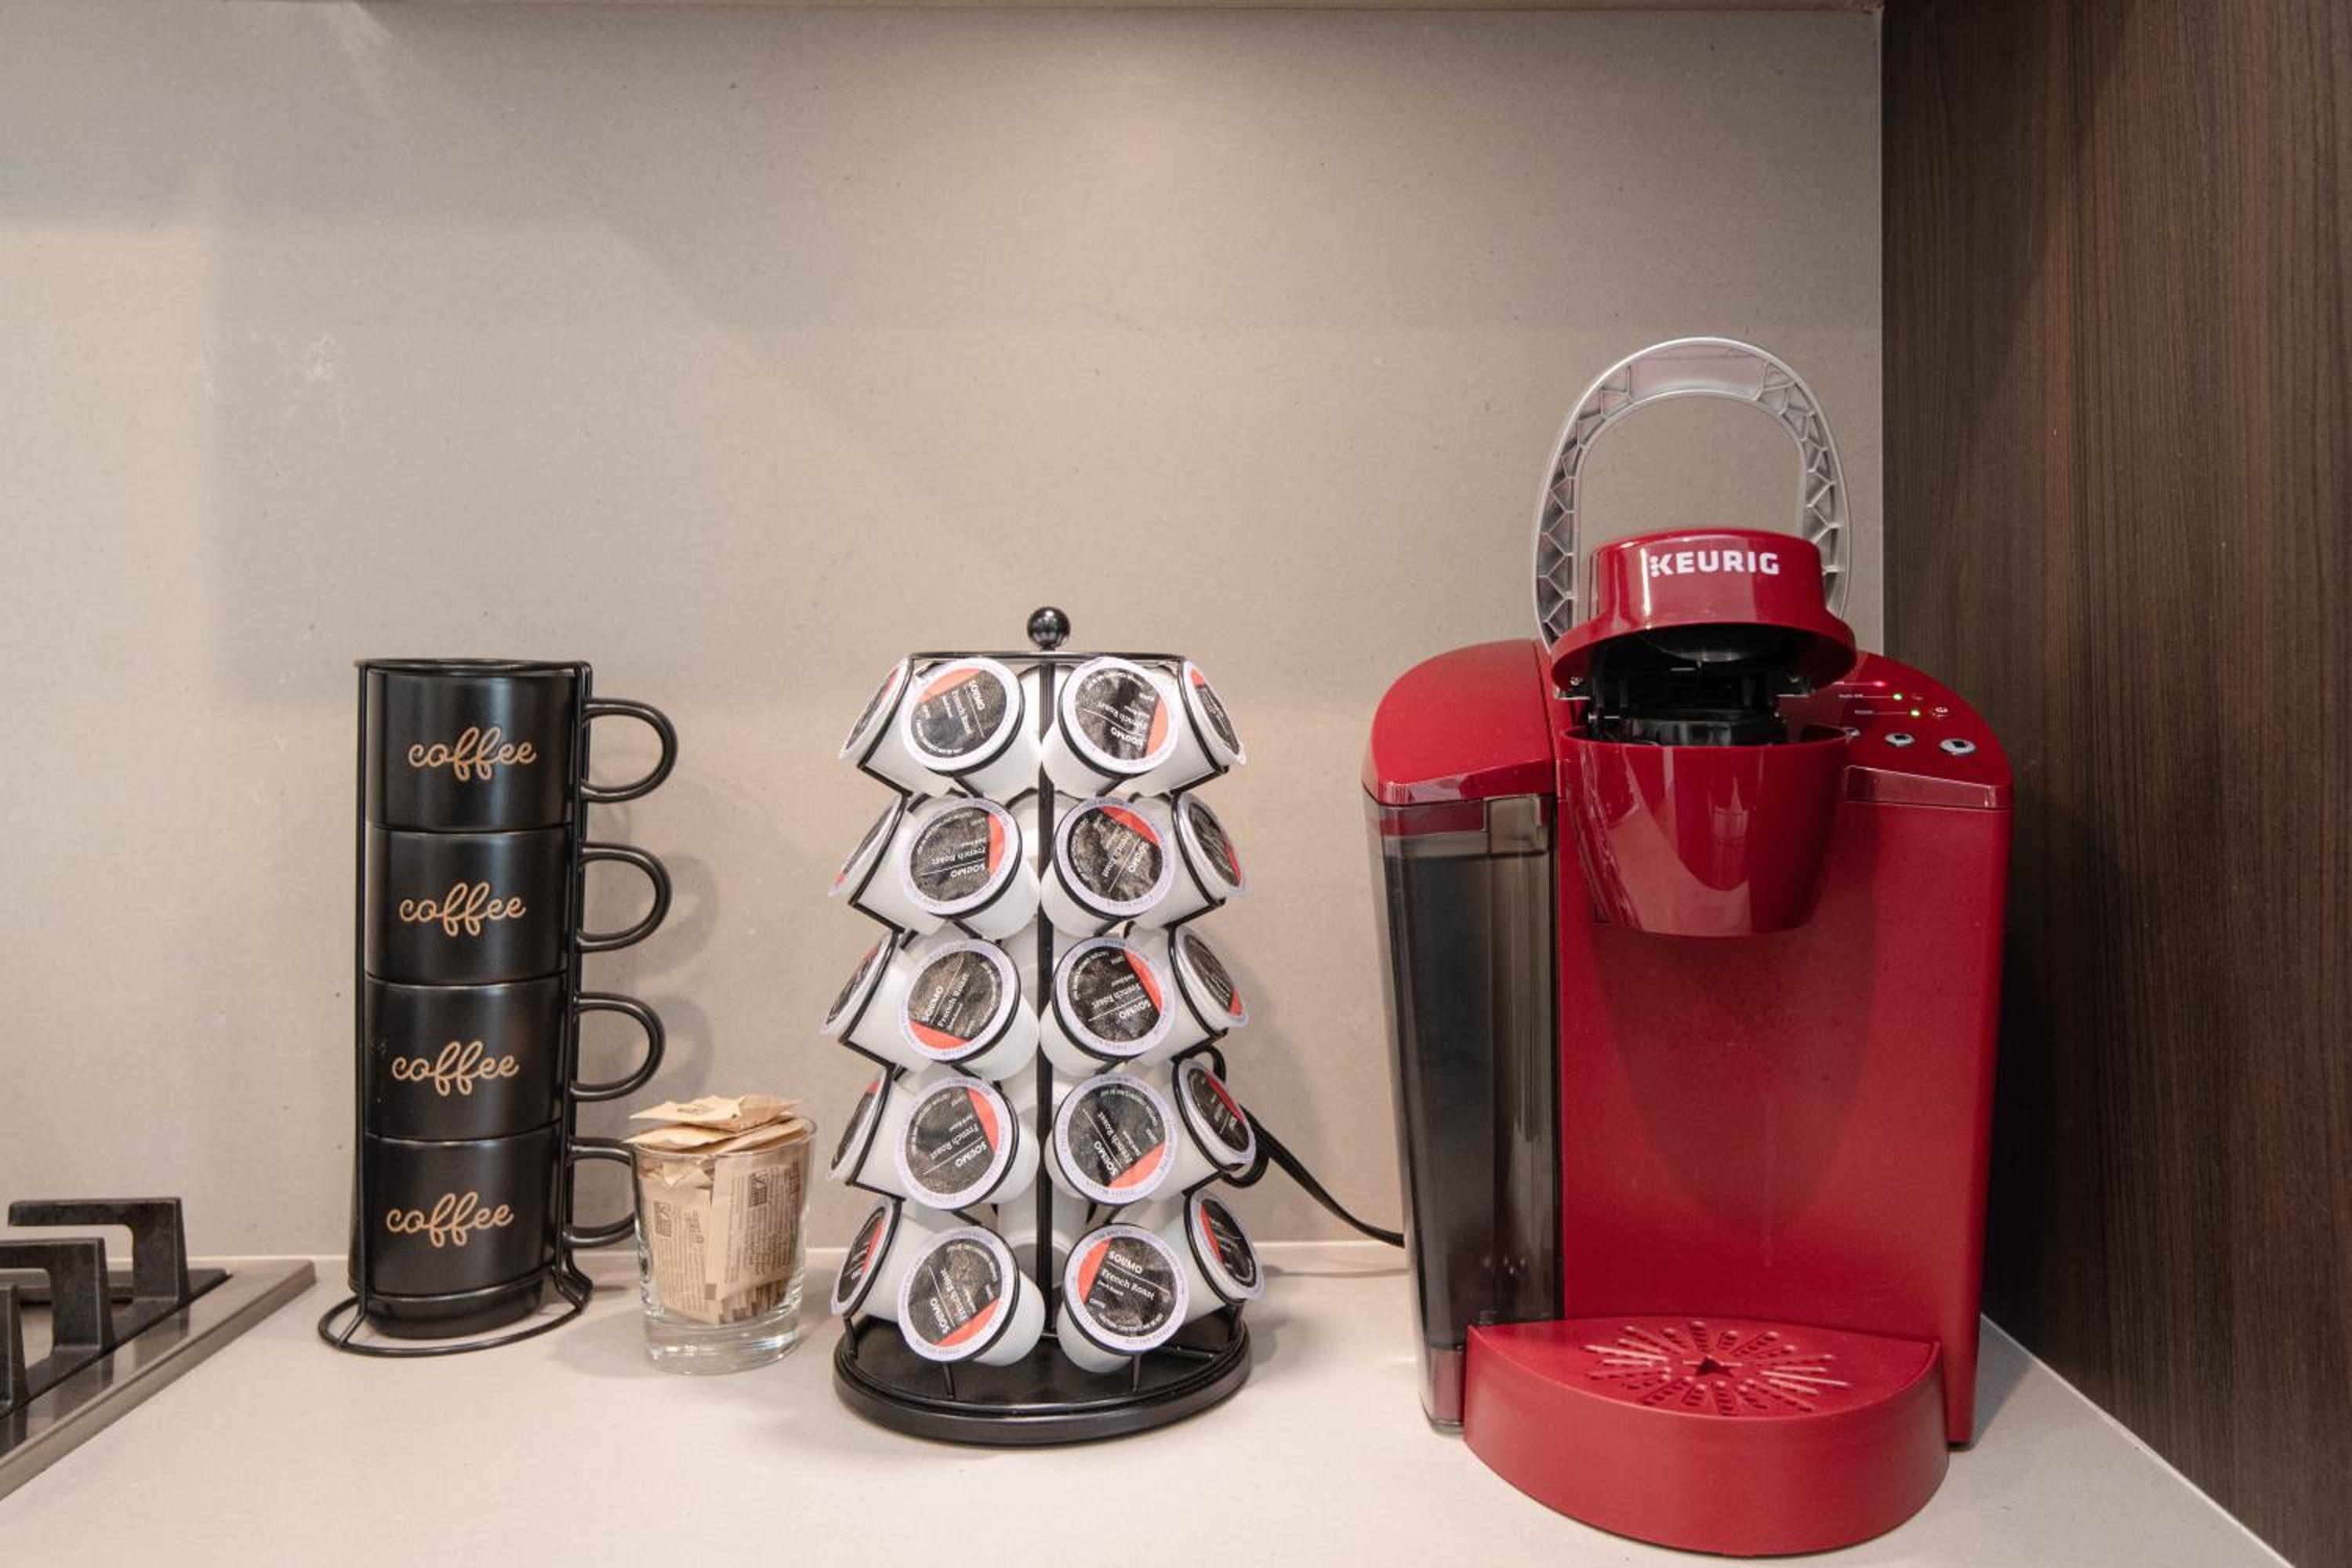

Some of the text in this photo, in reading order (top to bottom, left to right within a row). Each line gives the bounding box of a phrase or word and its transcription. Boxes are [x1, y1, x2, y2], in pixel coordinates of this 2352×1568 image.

[1650, 550, 1780, 577] KEURIG
[408, 727, 537, 781] coffee
[399, 882, 526, 937] coffee
[392, 1041, 520, 1096] coffee
[1095, 1111, 1115, 1136] Roast
[1109, 1134, 1133, 1164] French
[387, 1192, 514, 1247] coffee
[1100, 1268, 1131, 1289] French
